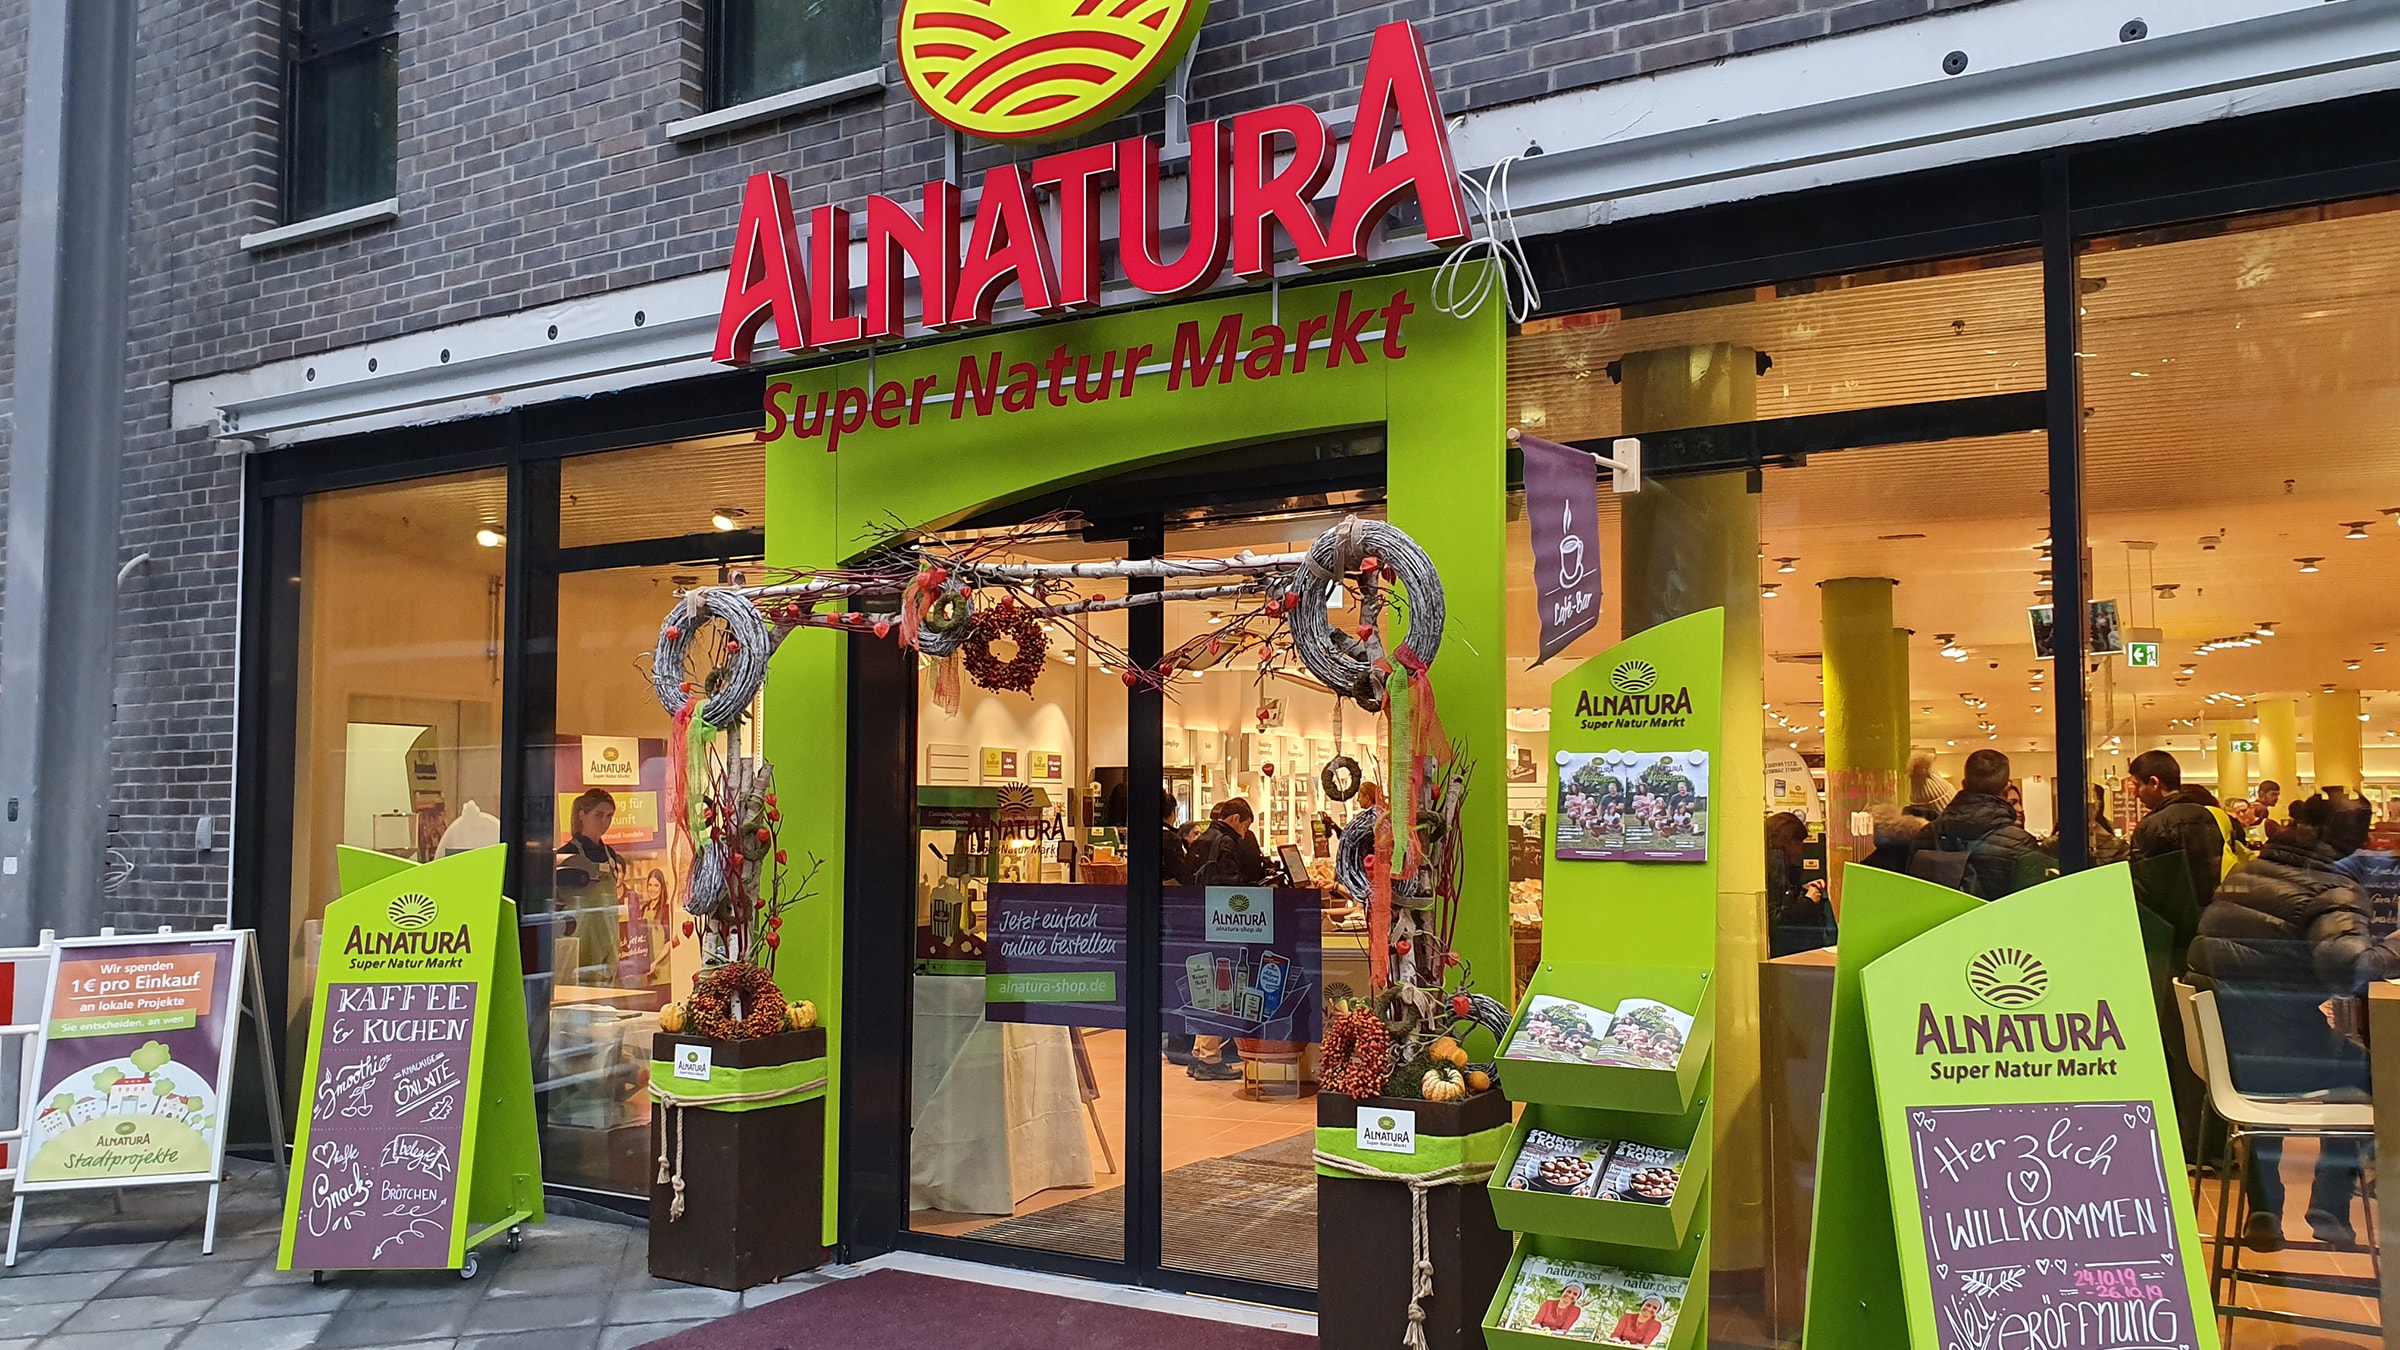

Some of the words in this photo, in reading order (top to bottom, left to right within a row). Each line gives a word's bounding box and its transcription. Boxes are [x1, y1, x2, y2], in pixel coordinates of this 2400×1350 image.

[712, 19, 1473, 367] ALNATURA
[755, 372, 938, 452] Super
[949, 341, 1153, 421] Natur
[1166, 289, 1416, 391] Markt
[1554, 590, 1593, 626] Café-Bar
[1574, 686, 1693, 717] ALNATURA
[1580, 719, 1613, 731] Super
[1615, 718, 1648, 729] Natur
[1649, 717, 1686, 728] Markt
[590, 759, 632, 774] ALNATURA
[629, 797, 643, 809] für
[970, 843, 998, 855] Sper
[1030, 842, 1058, 854] Mark
[999, 909, 1040, 932] Jetzt
[1042, 903, 1098, 933] einfach
[1212, 909, 1267, 926] ALNATURA
[344, 924, 471, 955] ALNATURA
[1000, 935, 1047, 957] online
[1050, 932, 1117, 955] bestellen
[100, 964, 121, 975] Wir
[124, 960, 174, 975] spenden
[349, 957, 386, 971] Super
[387, 957, 423, 970] Natur
[425, 957, 463, 969] Markt
[71, 979, 80, 994] 1
[83, 978, 97, 993] €
[100, 979, 129, 995] pro
[134, 971, 201, 990] Einkauf
[999, 978, 1106, 995] alnatura-shop.de
[79, 1003, 96, 1013] an
[98, 1000, 134, 1012] lokale
[136, 997, 185, 1011] Projekte
[337, 984, 469, 1013] KAFFEE
[61, 1023, 77, 1033] Sie
[79, 1017, 145, 1032] entscheiden,
[147, 1018, 161, 1026] an
[162, 1016, 184, 1025] wen
[332, 1018, 354, 1044] &
[361, 1018, 470, 1043] KUCHEN
[1915, 1000, 2127, 1055] ALNATURA
[678, 1060, 707, 1072] ALNATURA
[1930, 1060, 1990, 1084] Super
[1994, 1060, 2053, 1079] Natur
[2056, 1057, 2118, 1077] Markt
[96, 1133, 151, 1147] ALNATURA
[1363, 1127, 1410, 1143] ALNATURA
[1530, 1129, 1584, 1147] SCHROT
[1537, 1138, 1575, 1154] KORN
[1618, 1140, 1675, 1159] SCHROT
[63, 1147, 180, 1172] Stadtprojekte
[1625, 1149, 1666, 1165] KORN
[1945, 1197, 2158, 1251] WILLKOMMEN
[1622, 1277, 1683, 1294] natur.post
[2073, 1268, 2139, 1287] 24.10.19
